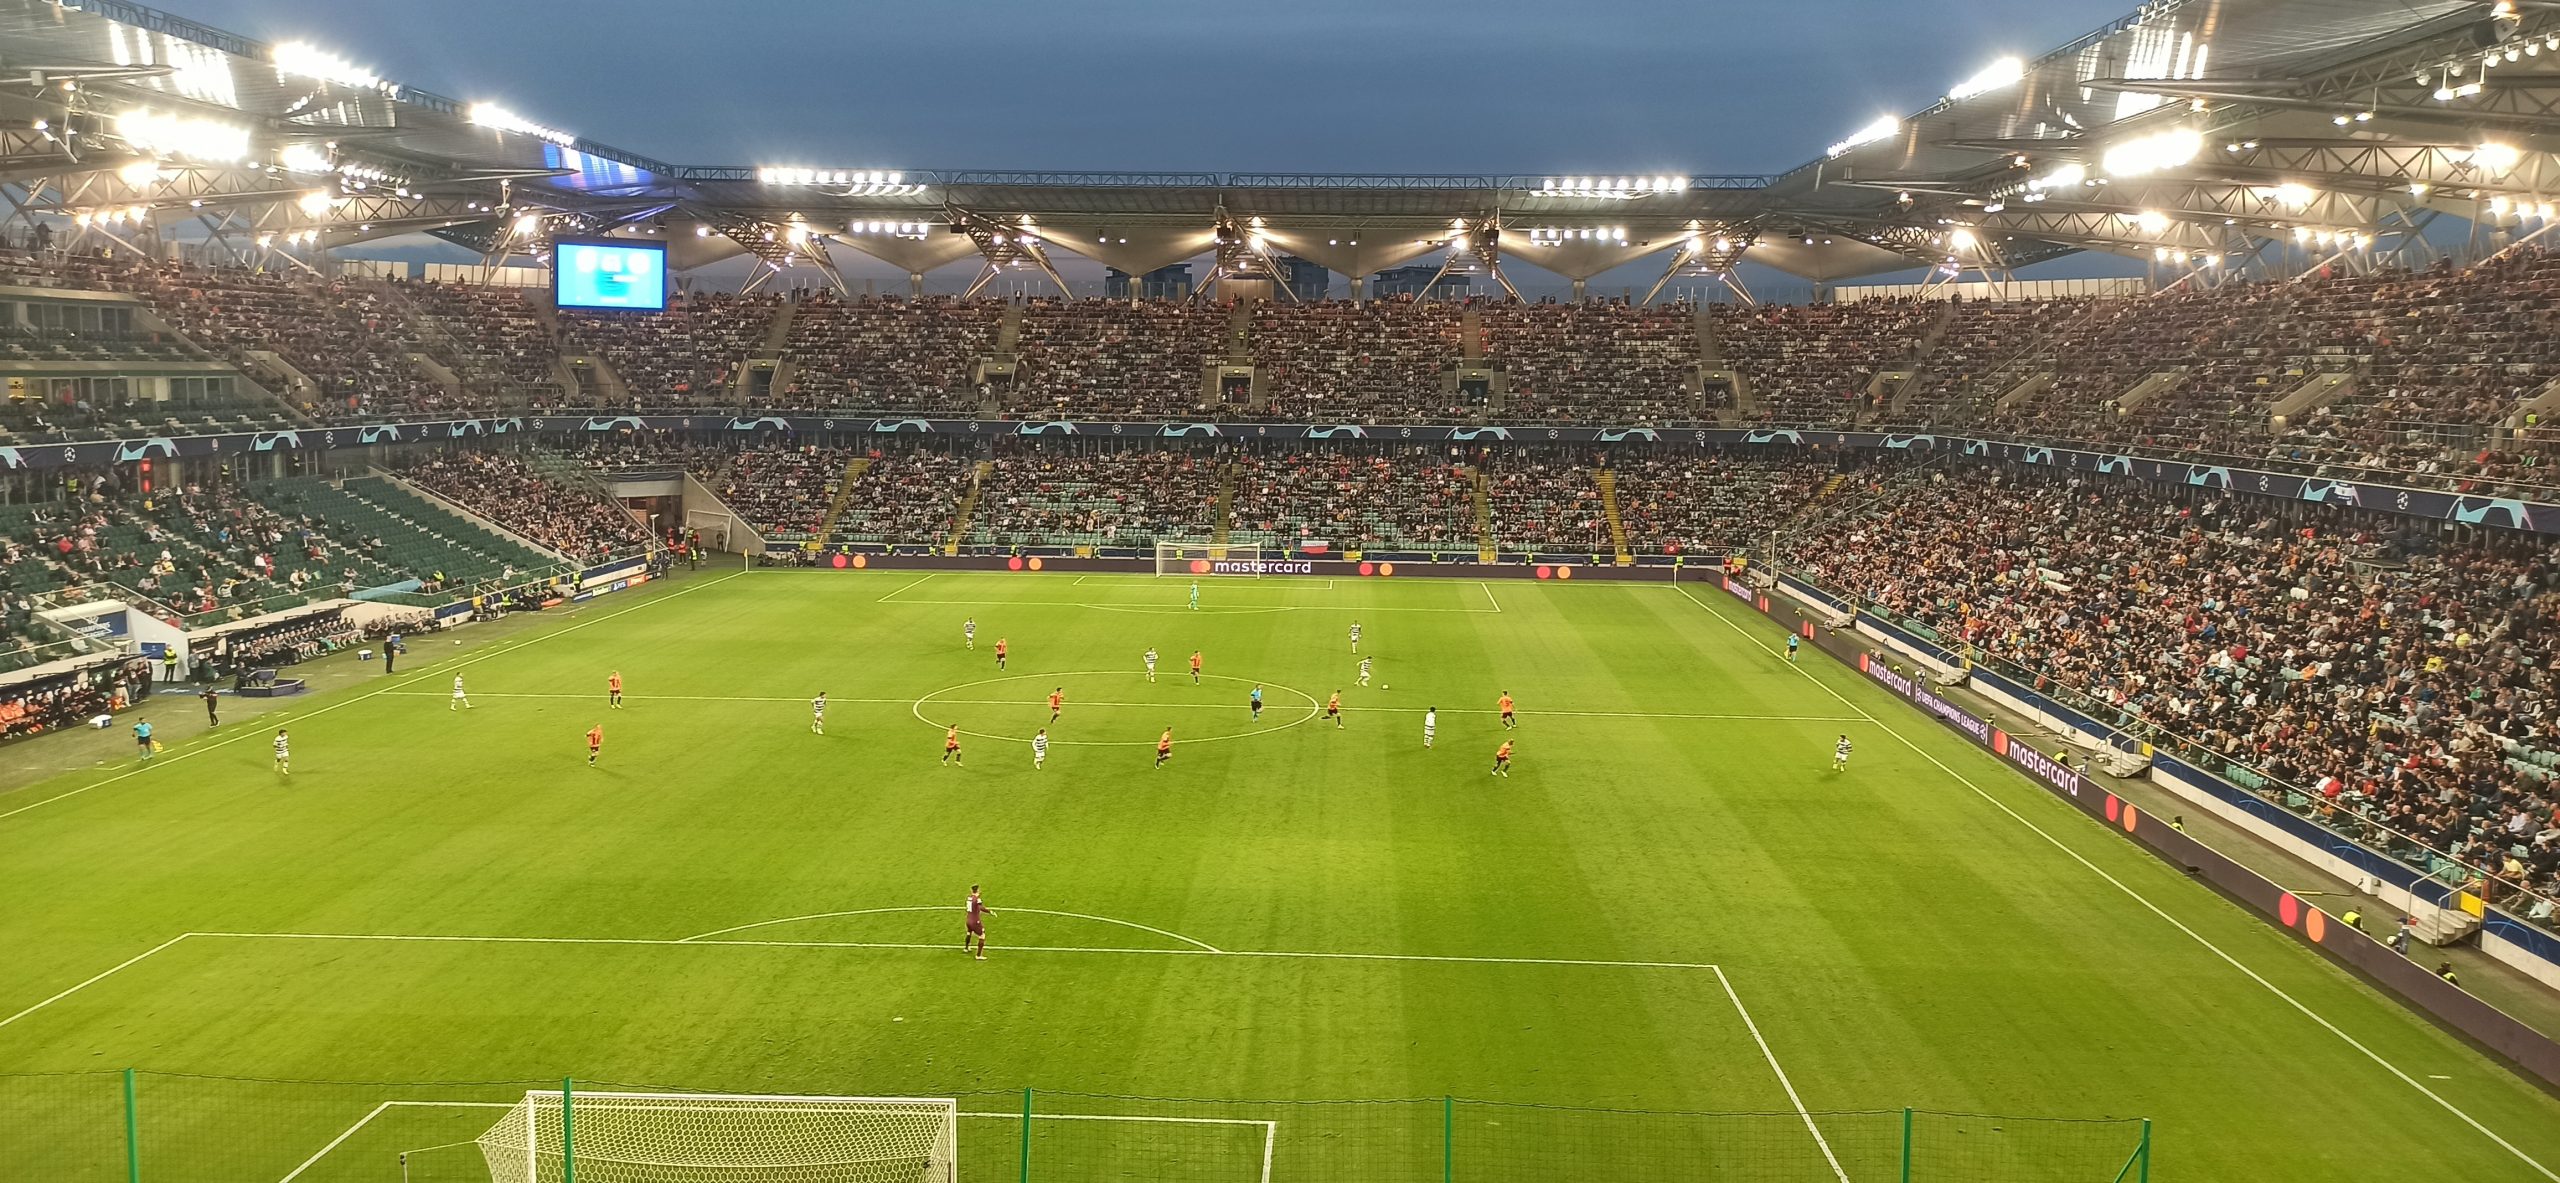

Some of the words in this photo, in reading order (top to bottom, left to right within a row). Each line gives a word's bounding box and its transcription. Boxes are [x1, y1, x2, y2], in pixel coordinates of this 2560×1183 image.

[1215, 561, 1311, 573] mastercard
[1869, 660, 1911, 697] mastercard
[1922, 691, 1934, 708] UEFA
[1933, 698, 1961, 724] CHAMPIONS
[1960, 714, 1980, 735] LEAGUE
[2009, 740, 2079, 797] mastercard
